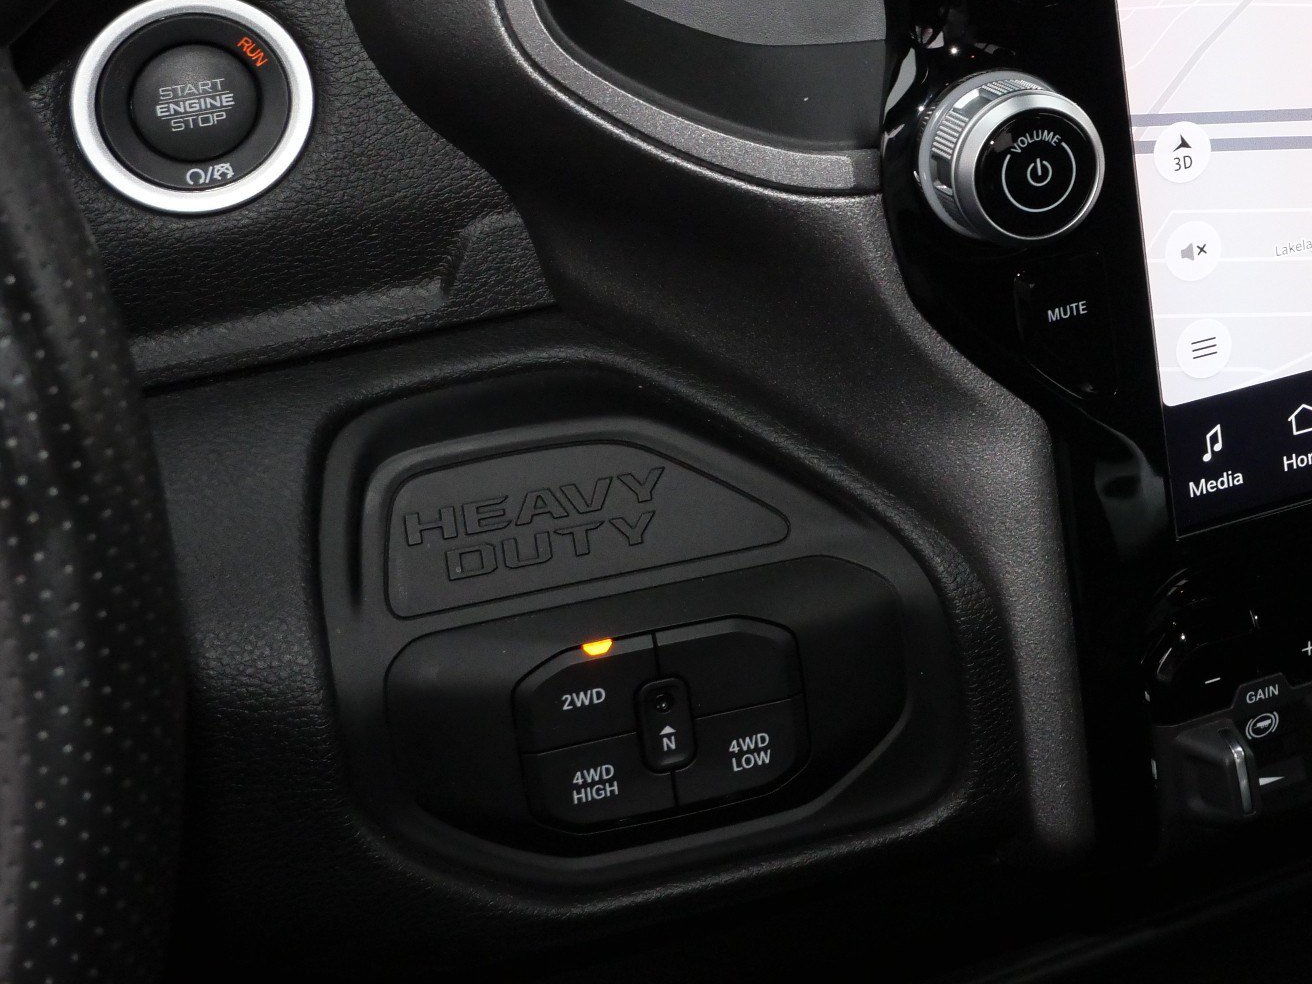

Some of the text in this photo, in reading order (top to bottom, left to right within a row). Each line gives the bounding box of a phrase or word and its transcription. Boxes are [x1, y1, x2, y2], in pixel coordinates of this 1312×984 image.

[235, 36, 268, 67] RUN
[159, 78, 226, 101] START
[155, 93, 236, 117] ENGINE
[171, 111, 227, 132] STOP
[1010, 130, 1062, 154] VOLUME
[1173, 155, 1193, 171] 3D
[1047, 300, 1088, 323] MUTE
[1188, 470, 1244, 498] Media
[404, 466, 666, 547] HEAVY
[445, 510, 656, 581] DUTY
[561, 687, 606, 711] 2WD
[1246, 684, 1279, 704] GAIN
[662, 735, 677, 751] N
[728, 732, 770, 754] 4WD
[731, 749, 772, 772] LOW
[573, 763, 615, 787] 4WD
[573, 780, 619, 805] HIGH
